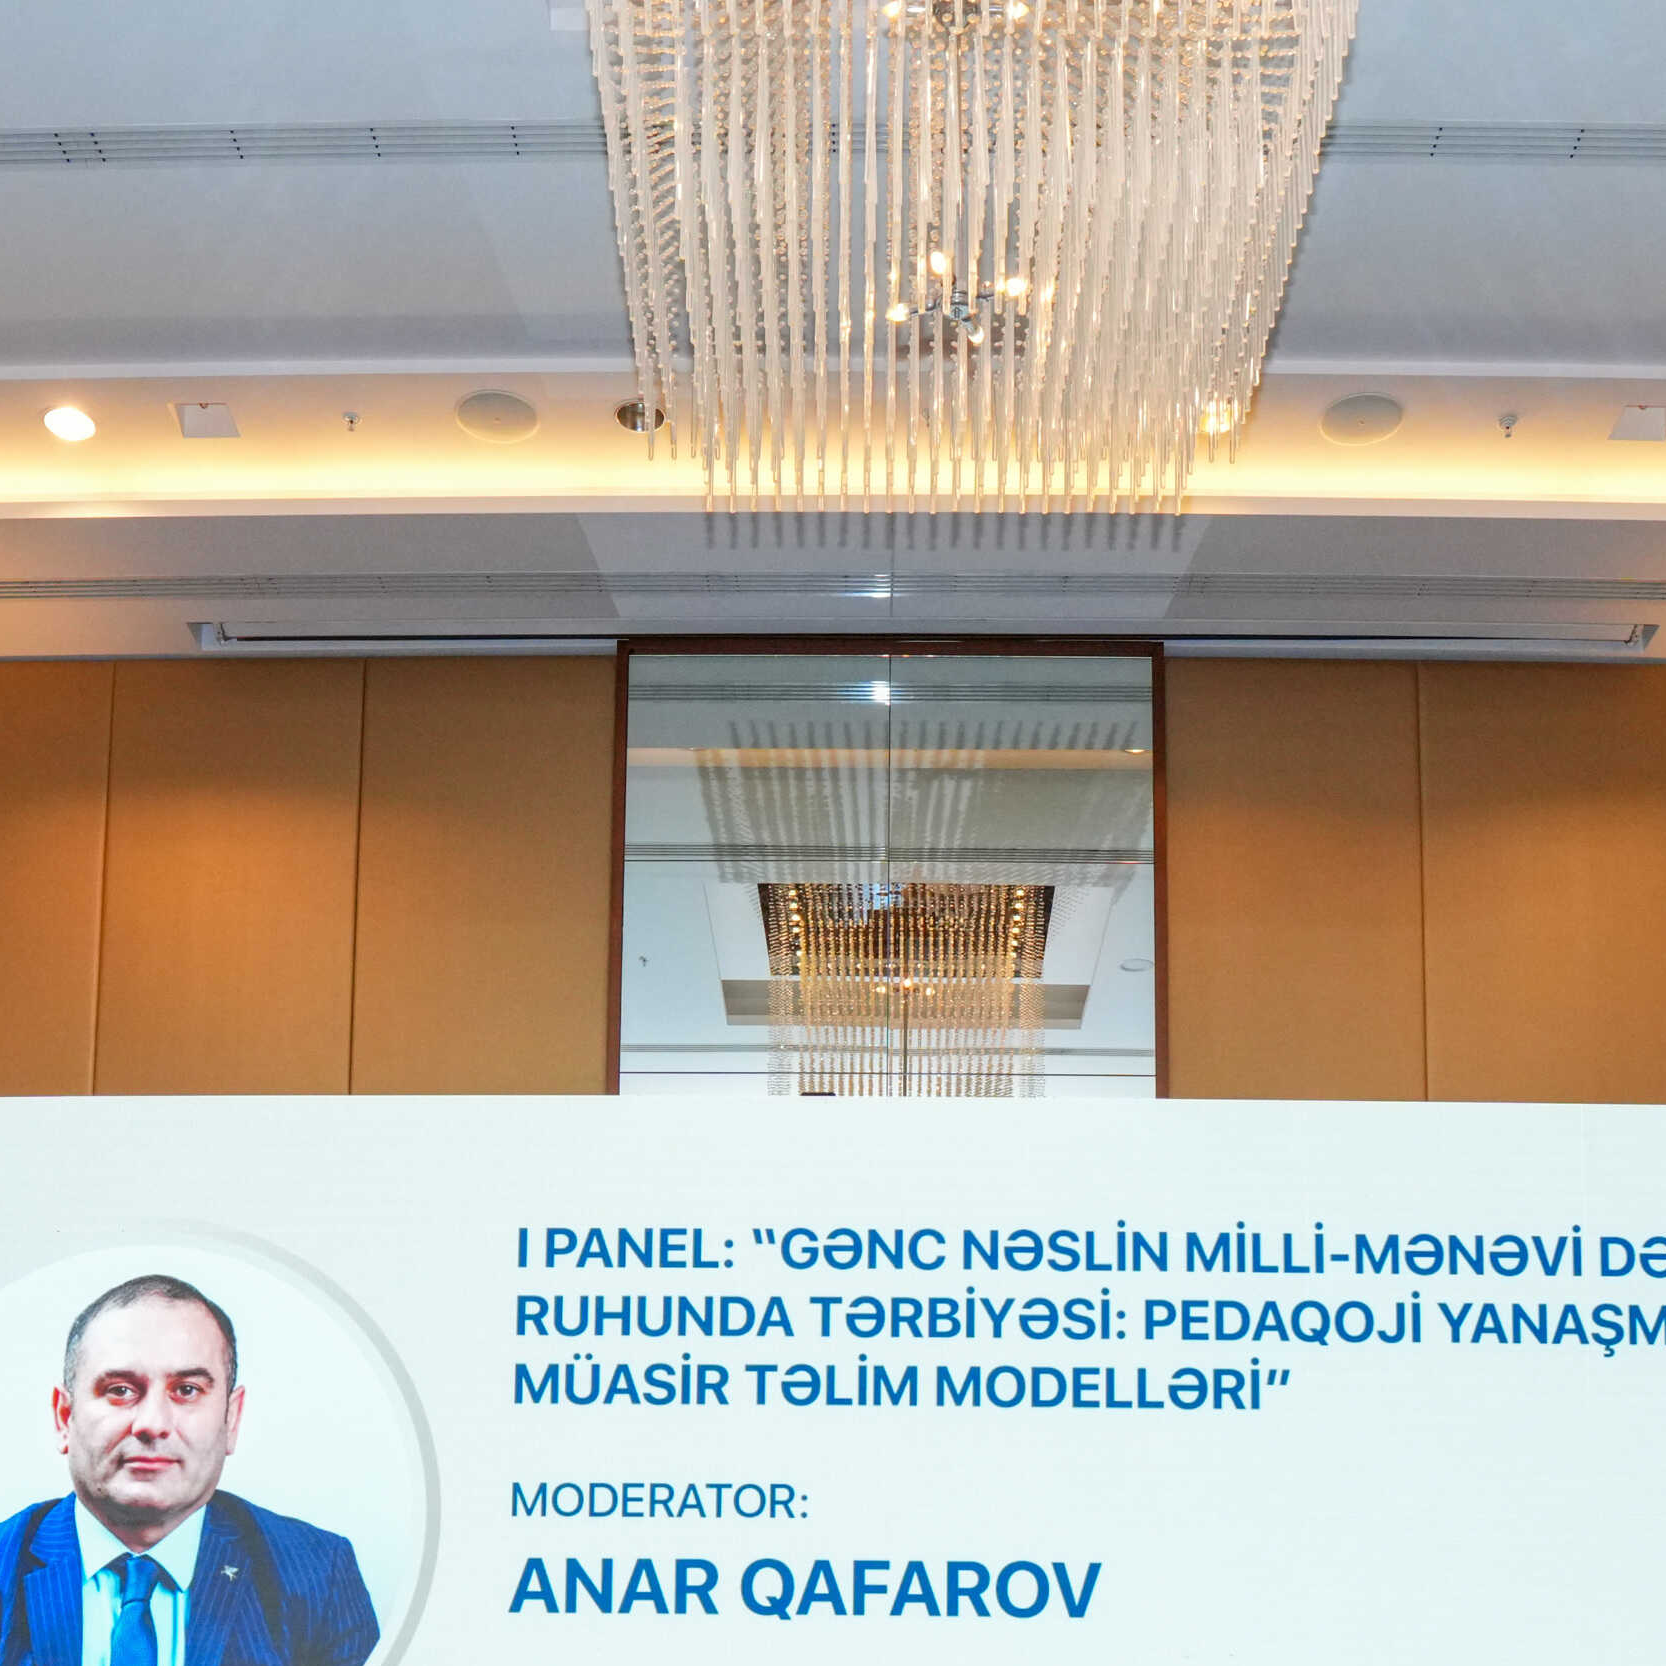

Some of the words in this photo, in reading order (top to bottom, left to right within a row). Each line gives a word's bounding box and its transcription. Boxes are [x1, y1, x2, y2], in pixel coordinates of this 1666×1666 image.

[516, 1228, 529, 1268] I
[544, 1227, 735, 1269] PANEL:
[962, 1220, 1169, 1272] NƏSLİN
[1185, 1221, 1583, 1277] MİLLİ-MƏNƏVİ
[515, 1294, 795, 1337] RUHUNDA
[809, 1286, 1127, 1339] TƏRBİYƏSİ:
[1144, 1290, 1422, 1346] PEDAQOJİ
[513, 1352, 730, 1405] MÜASİR
[744, 1354, 918, 1406] TƏLİM
[510, 1482, 809, 1519] MODERATOR:
[508, 1557, 720, 1615] ANAR
[740, 1558, 1103, 1620] QAFAROV
